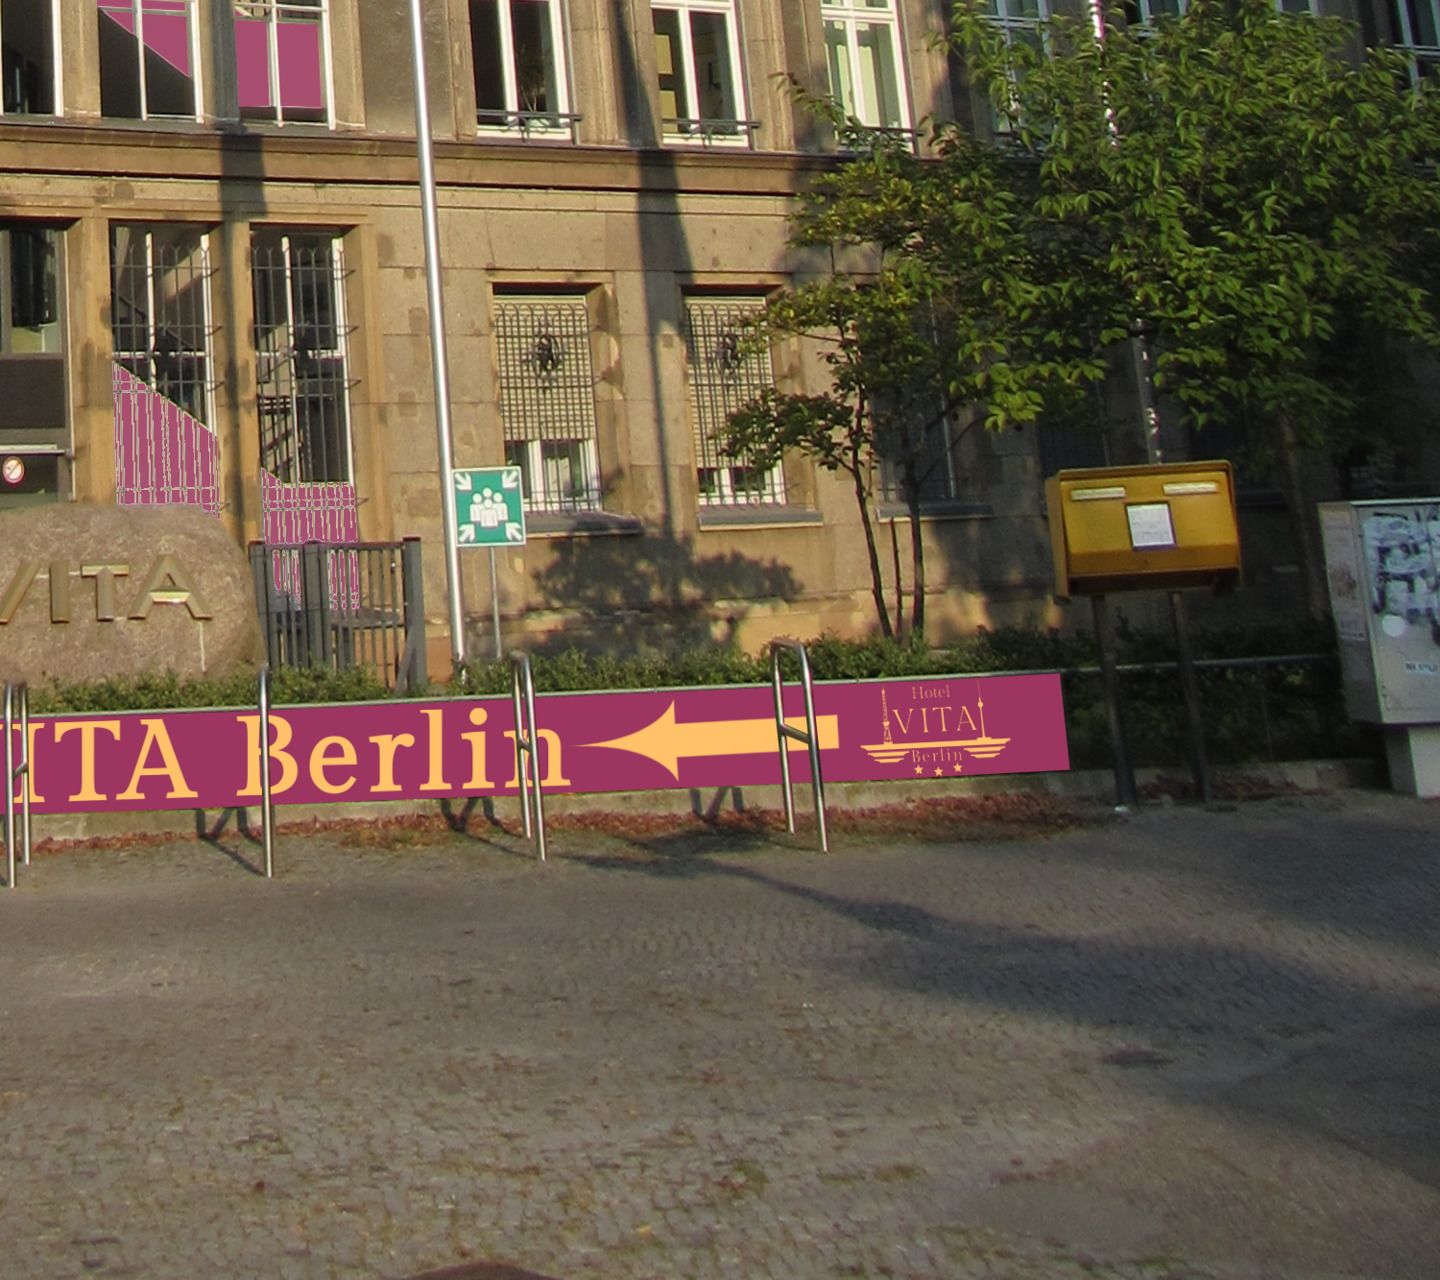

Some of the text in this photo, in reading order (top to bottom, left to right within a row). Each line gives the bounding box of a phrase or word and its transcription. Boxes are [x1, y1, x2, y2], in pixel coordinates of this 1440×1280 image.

[912, 684, 951, 700] Hotel
[892, 705, 977, 735] VITA
[235, 706, 573, 799] Berlin
[912, 748, 963, 763] Berlin
